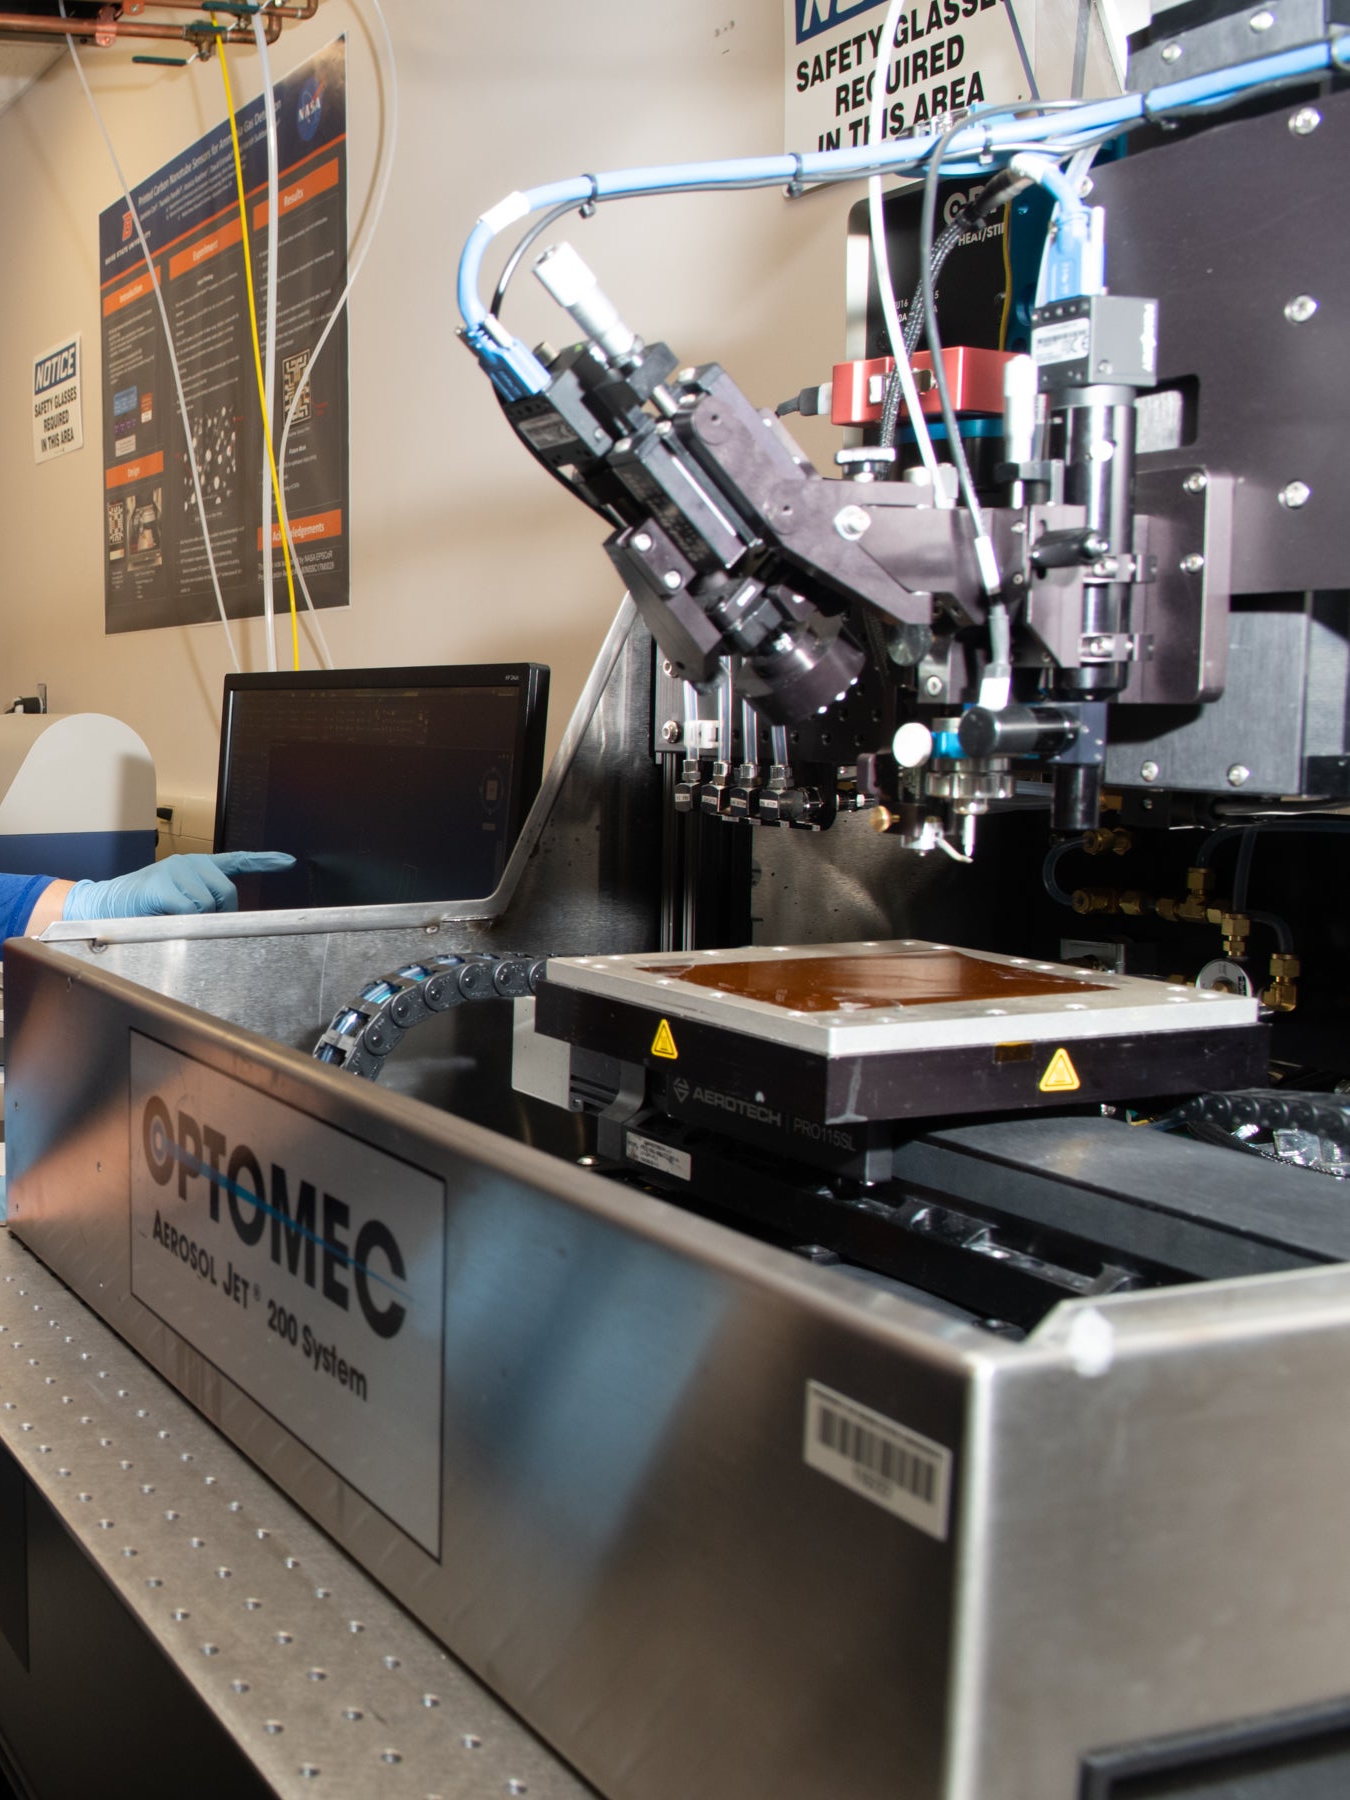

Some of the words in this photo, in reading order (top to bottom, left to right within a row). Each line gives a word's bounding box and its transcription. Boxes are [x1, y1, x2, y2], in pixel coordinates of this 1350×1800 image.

[796, 24, 883, 92] SAFETY
[893, 0, 1003, 49] GLASS
[298, 96, 321, 122] NASA
[818, 128, 841, 152] IN
[849, 102, 905, 147] TIS
[913, 71, 985, 125] AREA
[192, 150, 211, 170] Sensors
[219, 125, 243, 150] Ammia
[243, 118, 254, 132] Gas
[254, 100, 282, 126] Deton
[284, 188, 304, 207] Results
[35, 346, 75, 391] NOTICE
[34, 398, 53, 418] SAFETY
[54, 386, 77, 408] GLASSES
[43, 409, 69, 432] REQUIRED
[41, 437, 47, 453] IN
[48, 433, 60, 449] THIS
[61, 427, 75, 445] AREA
[272, 522, 325, 542] Ackledgements
[692, 1086, 782, 1128] AEROTECH
[793, 1116, 856, 1152] PRO115SL
[142, 1095, 407, 1340] OPTOMEC
[152, 1210, 218, 1286] AEROSOL
[267, 1299, 298, 1347] 200
[301, 1323, 368, 1402] System
